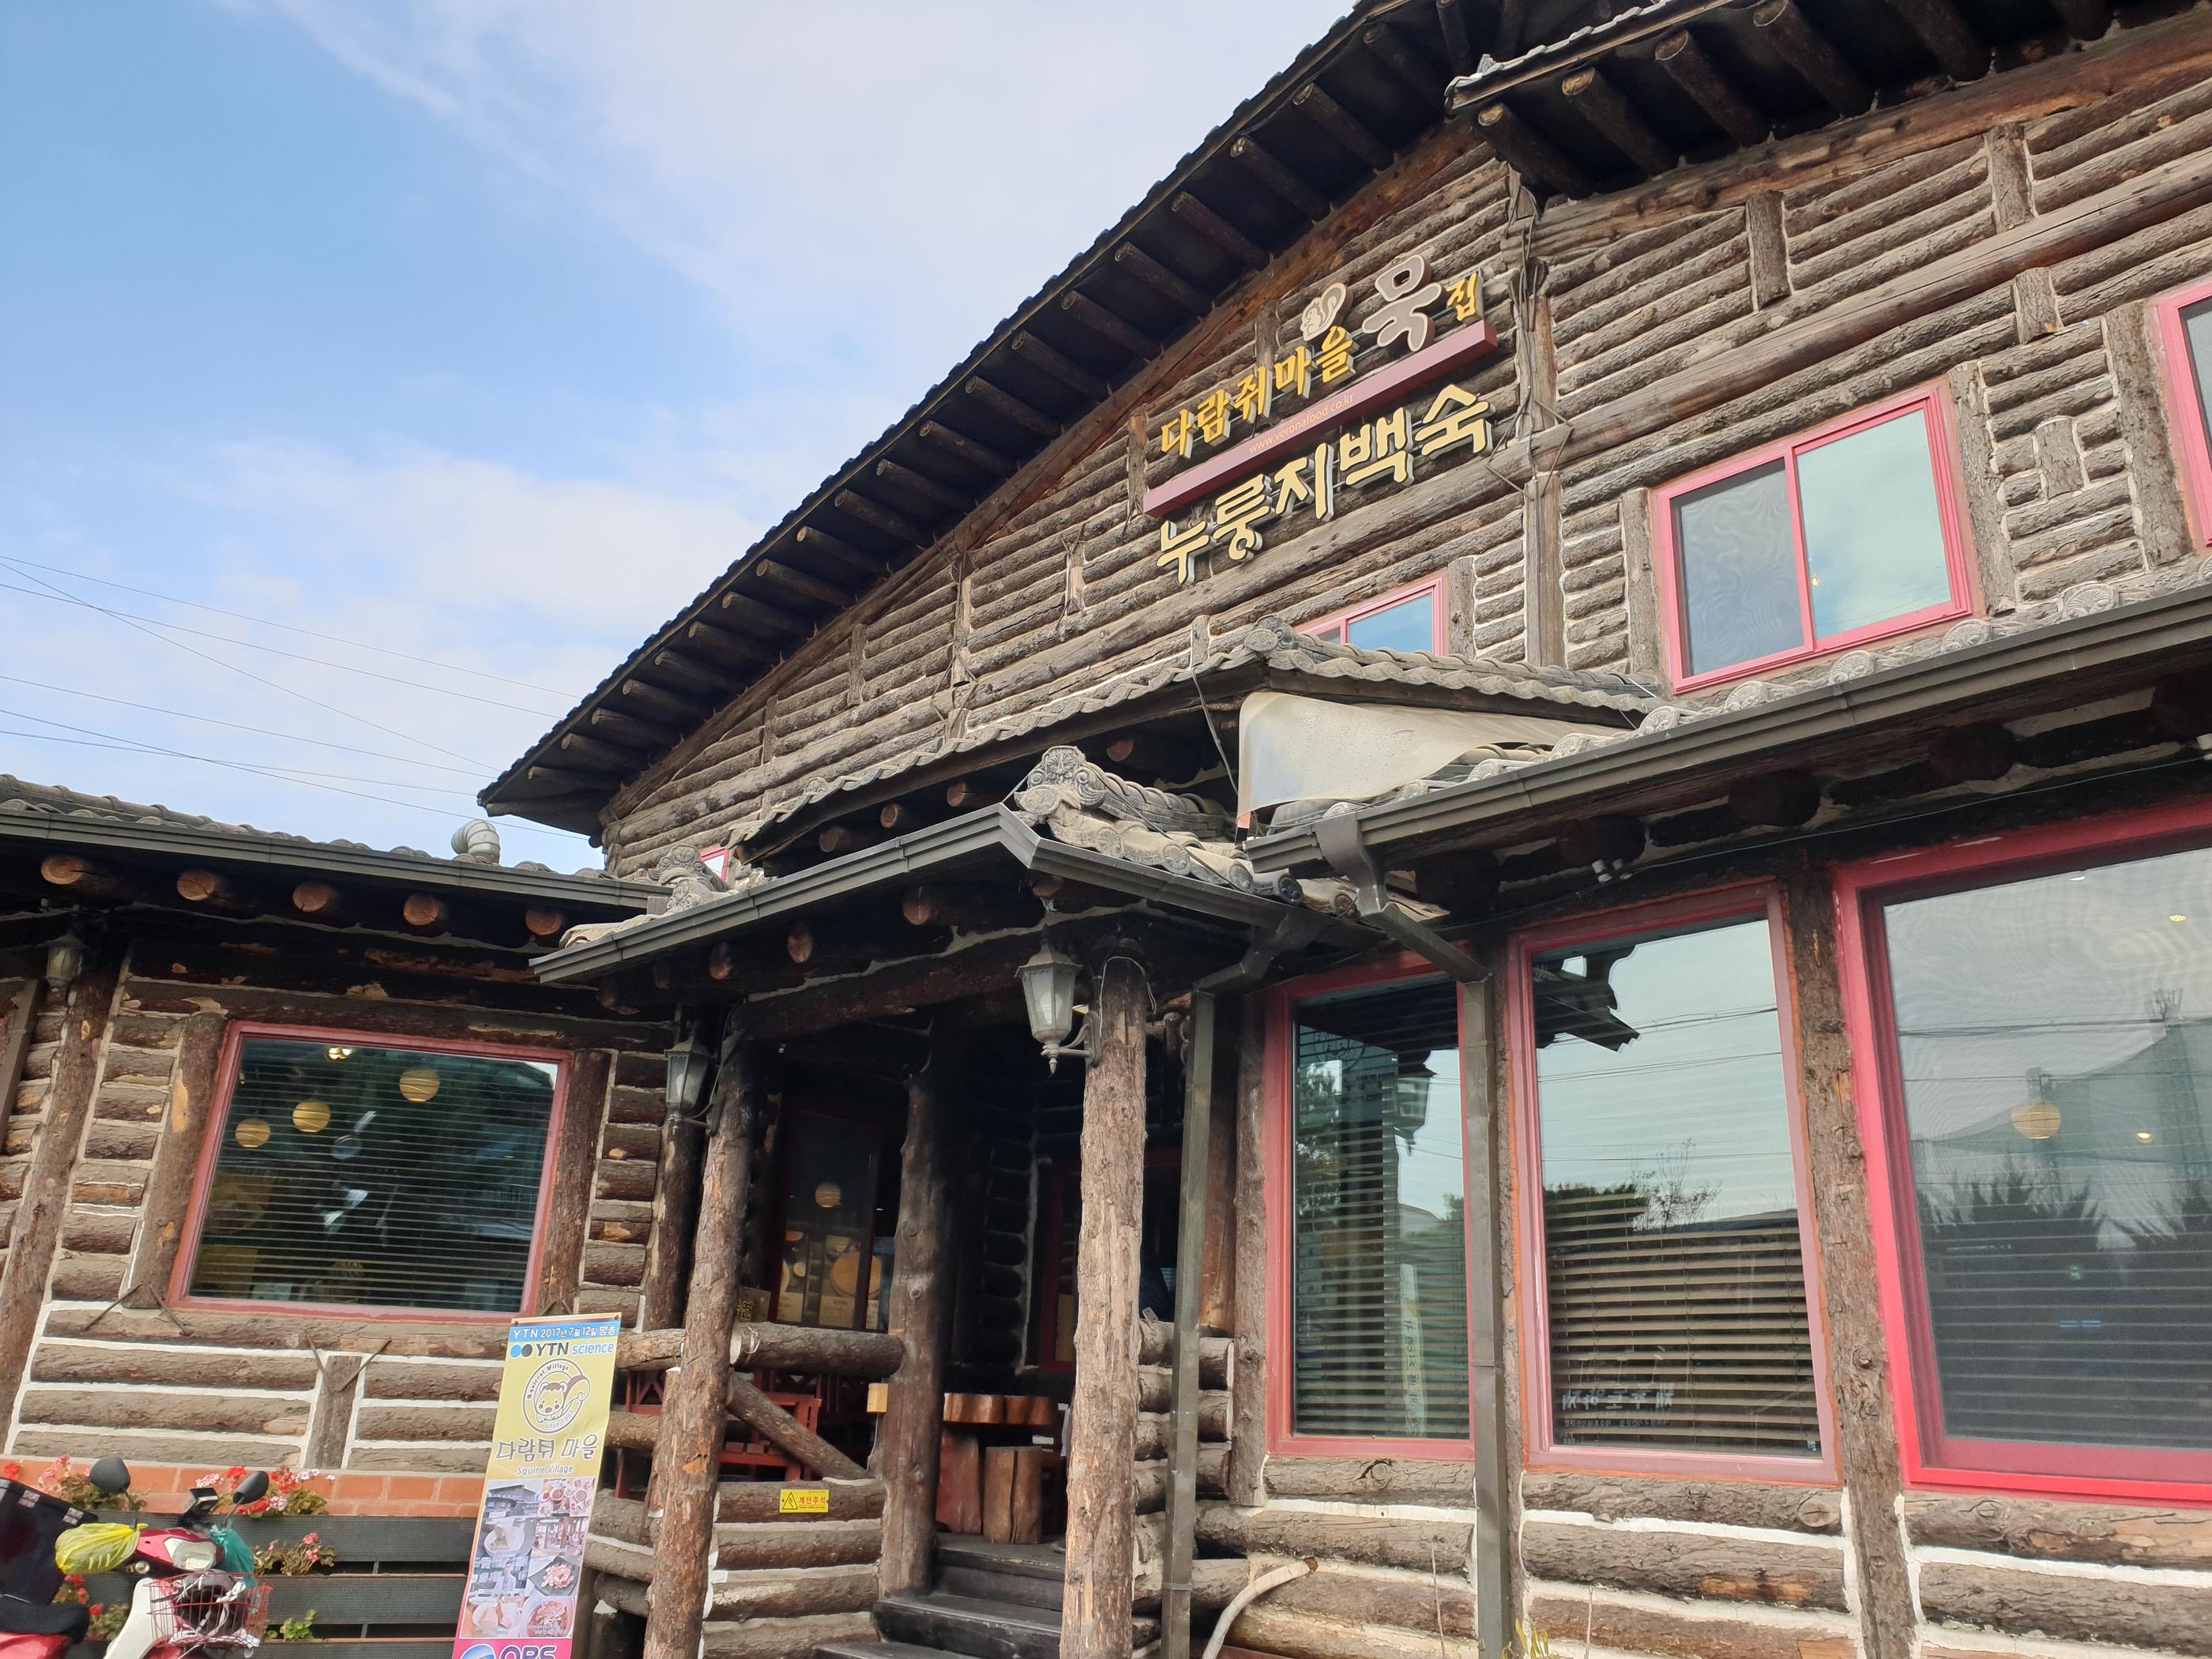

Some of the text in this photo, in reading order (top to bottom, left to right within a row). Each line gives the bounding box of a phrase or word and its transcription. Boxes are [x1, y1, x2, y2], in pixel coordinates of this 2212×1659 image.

[1161, 325, 1358, 458] 다람쥐마을
[1248, 394, 1354, 454] www.veronafood.co.kr
[1156, 384, 1494, 584] 누룽지백숙
[514, 1324, 616, 1339] YTN 2017년 7월 12일 방송
[536, 1342, 615, 1356] YTN science
[561, 1434, 598, 1460] 마을
[517, 1465, 574, 1476] Squirrel Village
